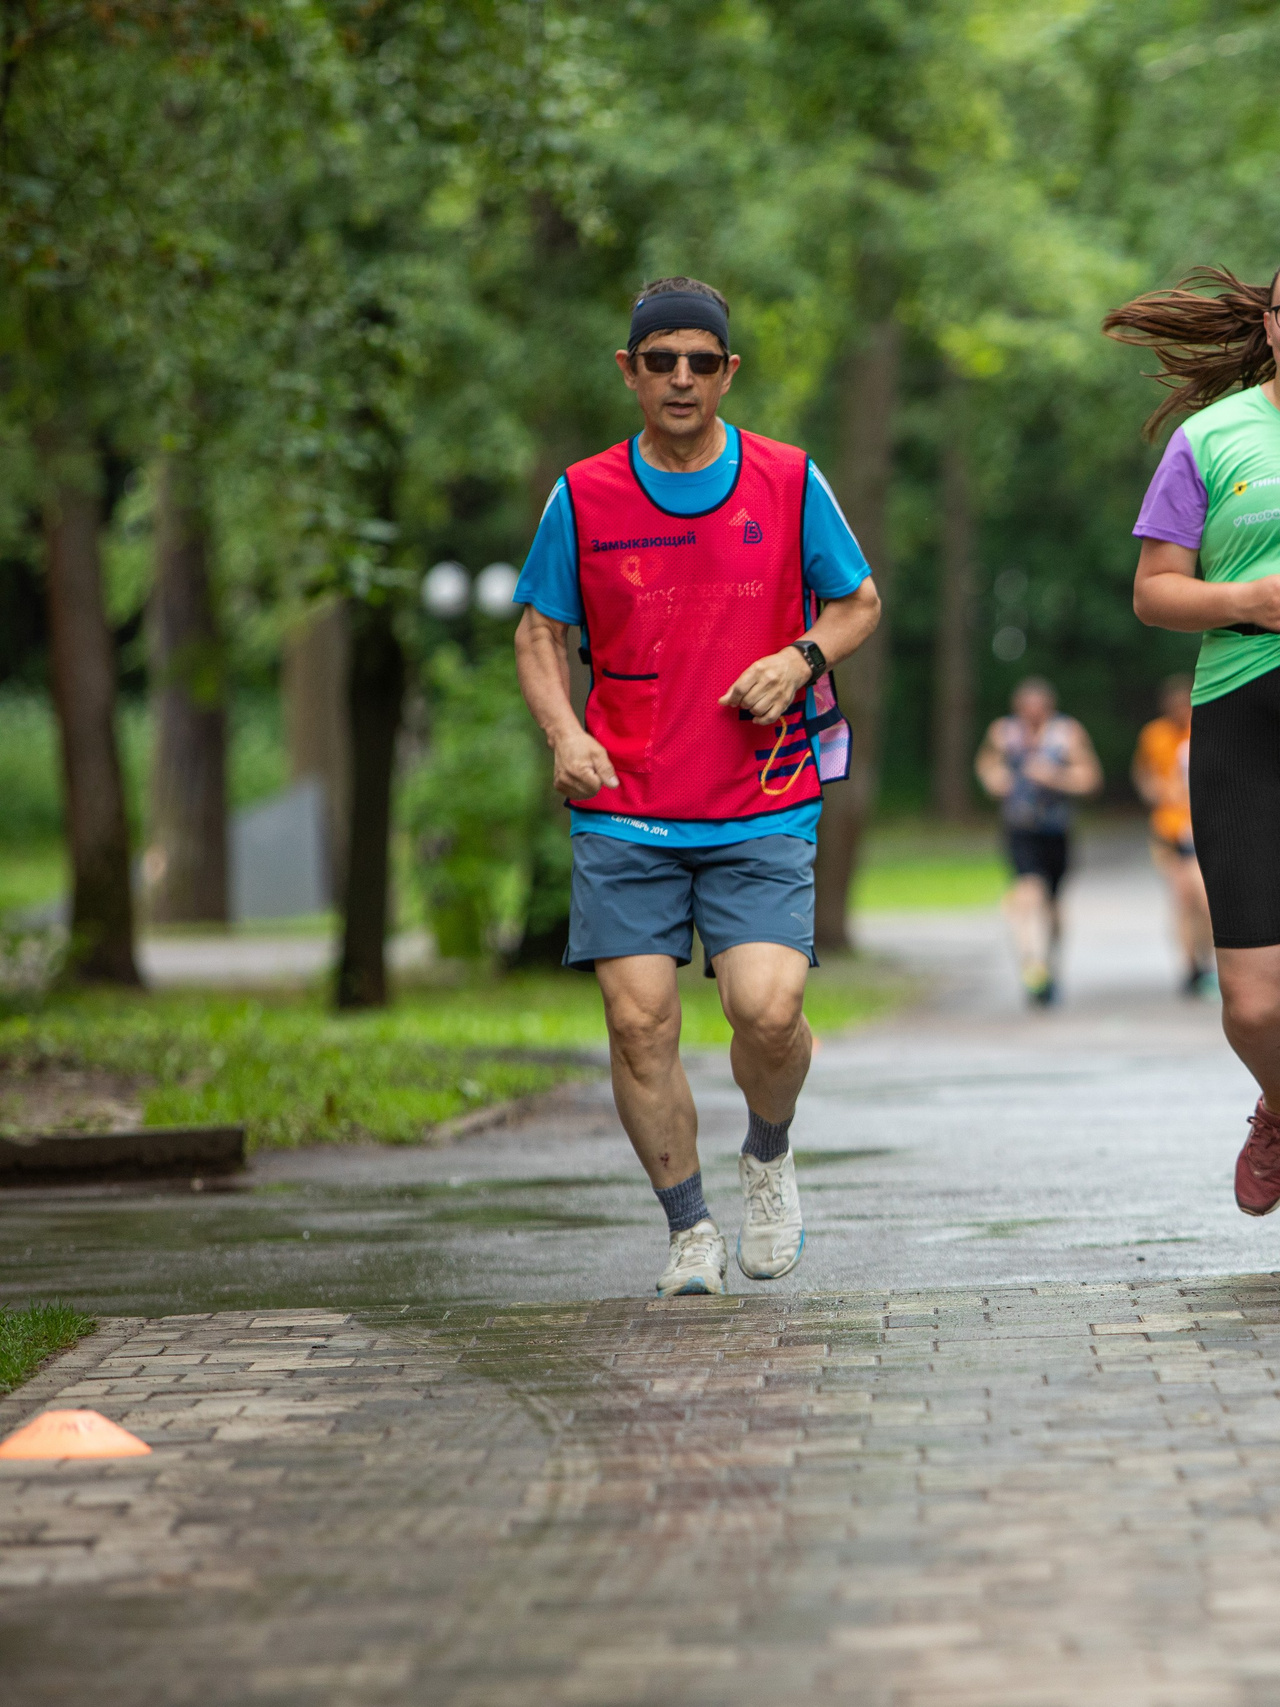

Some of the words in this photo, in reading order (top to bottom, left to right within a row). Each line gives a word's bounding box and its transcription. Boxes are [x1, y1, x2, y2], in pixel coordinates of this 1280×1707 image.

[591, 531, 696, 552] Замыкающий
[610, 814, 649, 832] СЕНТЯБРЬ
[650, 825, 669, 837] 2014
